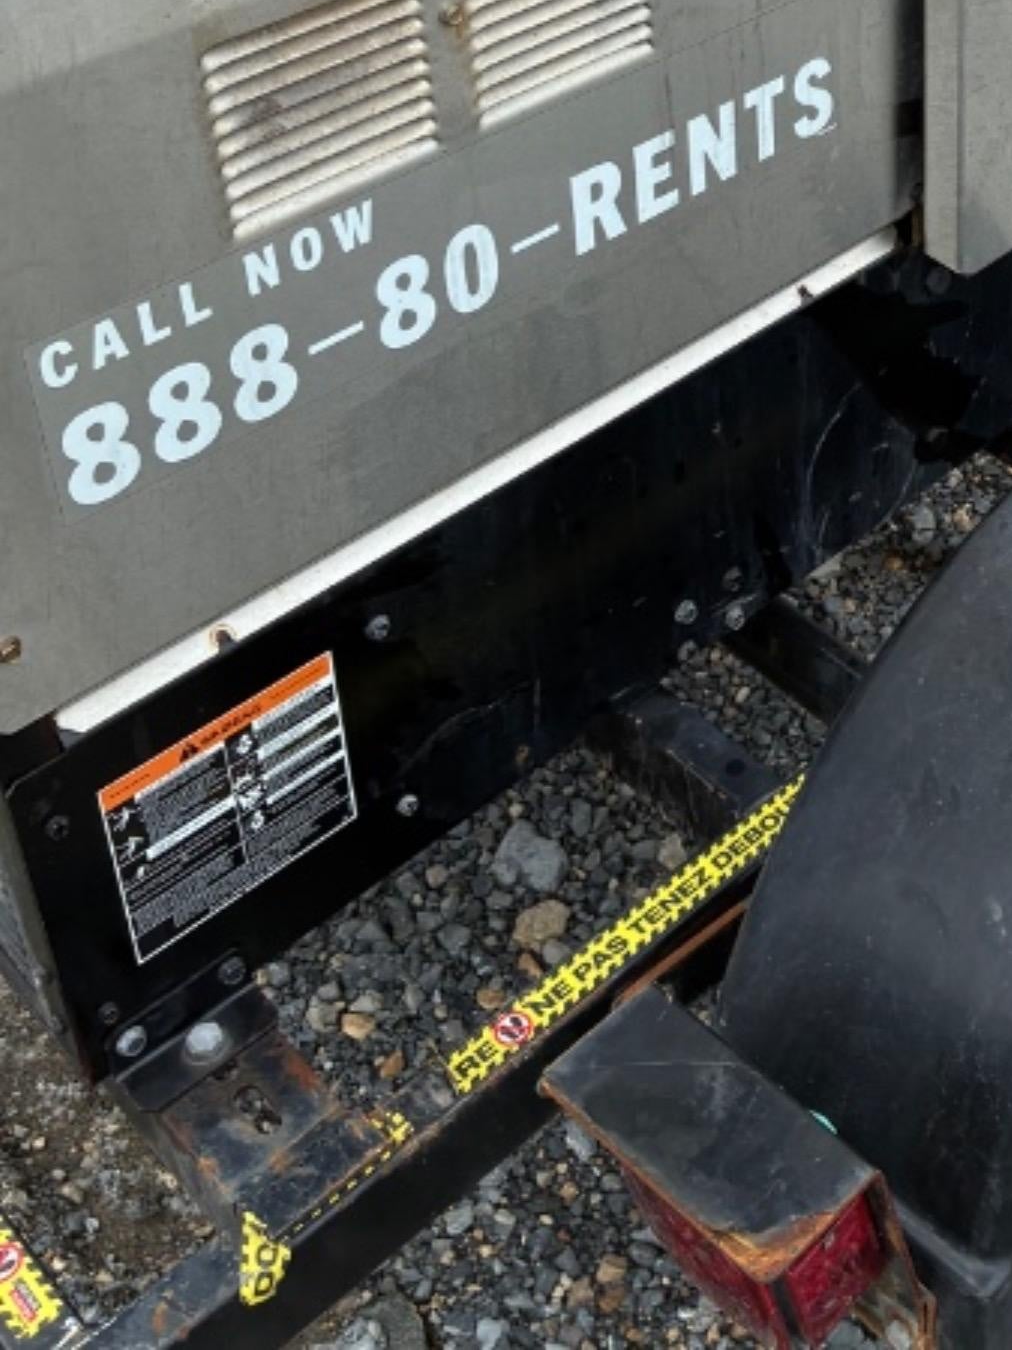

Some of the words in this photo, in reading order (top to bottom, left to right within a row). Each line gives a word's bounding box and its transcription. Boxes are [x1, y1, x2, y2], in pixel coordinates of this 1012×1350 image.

[39, 283, 212, 388] CALL
[243, 199, 375, 296] NOW
[526, 978, 574, 1016] NE
[574, 934, 629, 981] PAS
[631, 873, 711, 936] TENEZ
